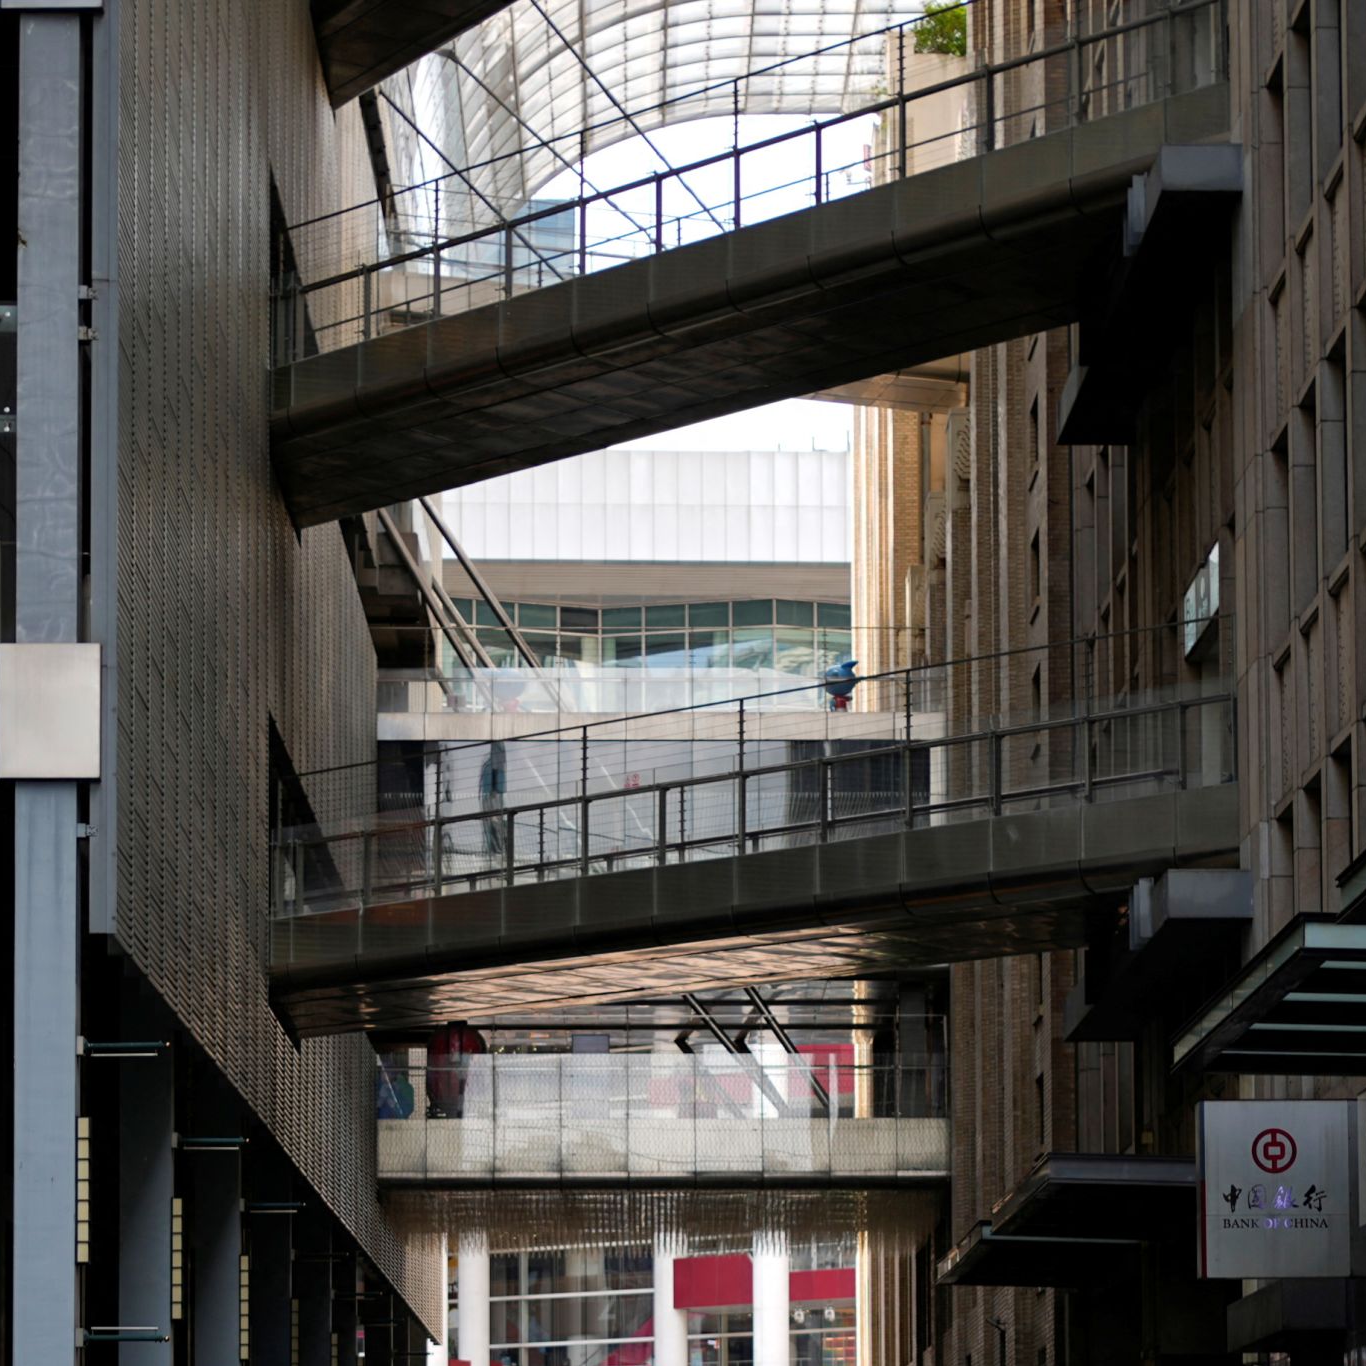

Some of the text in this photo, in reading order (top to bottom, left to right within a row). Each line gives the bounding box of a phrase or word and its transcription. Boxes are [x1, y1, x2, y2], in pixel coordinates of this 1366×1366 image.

[1223, 1218, 1328, 1229] BANK OF CHINA
